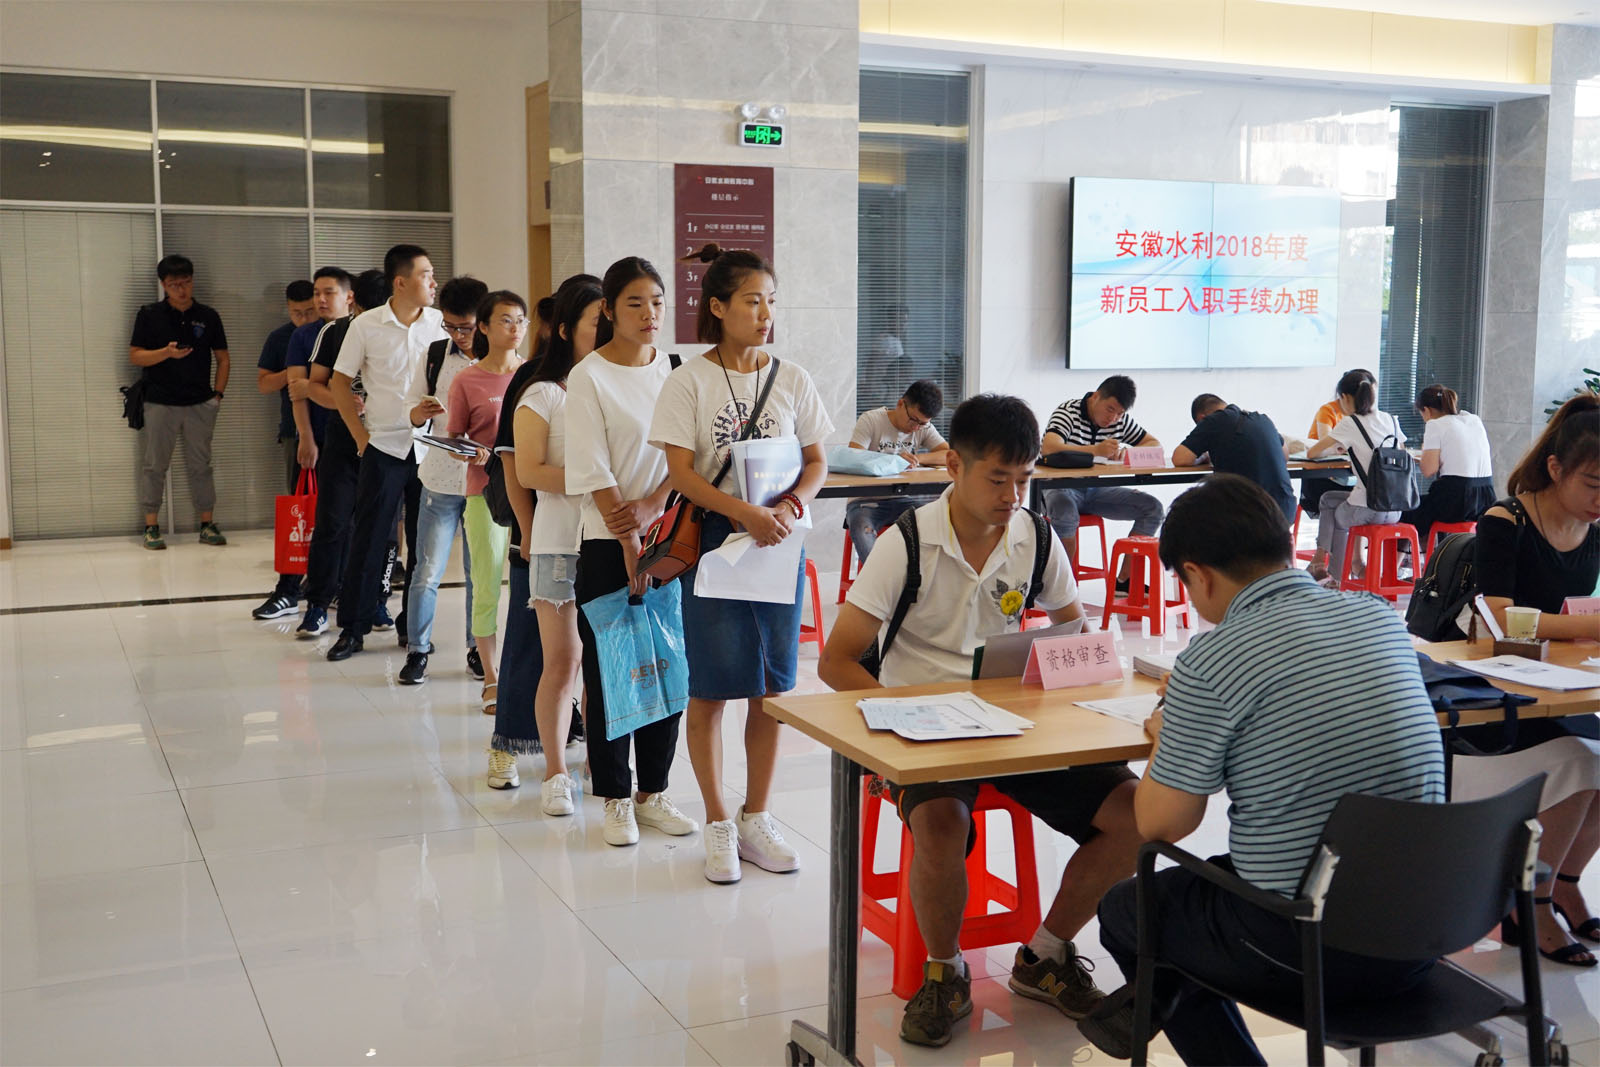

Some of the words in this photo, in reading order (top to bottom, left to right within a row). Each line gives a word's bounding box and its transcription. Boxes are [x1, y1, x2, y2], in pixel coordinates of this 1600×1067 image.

[1115, 229, 1309, 261] 安徽水利2018年度
[1100, 285, 1319, 314] 新员工入职手续办理
[1046, 643, 1110, 671] 资格审查
